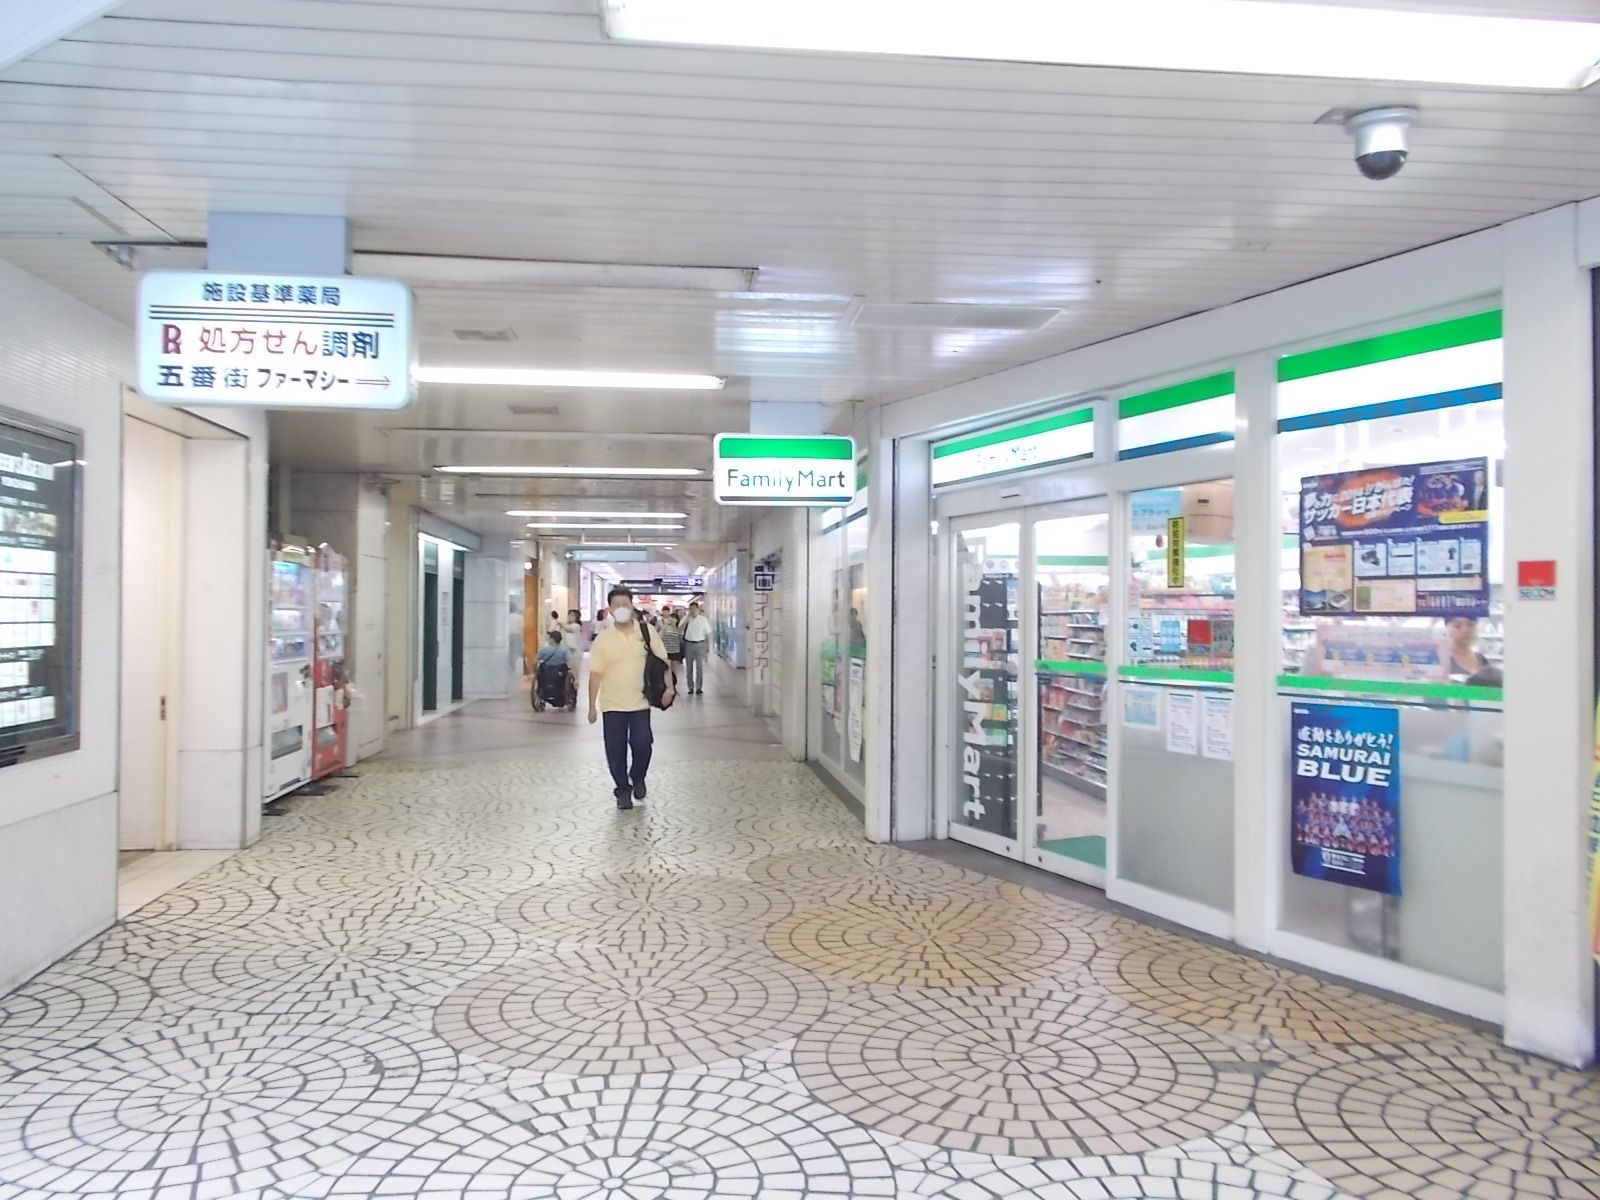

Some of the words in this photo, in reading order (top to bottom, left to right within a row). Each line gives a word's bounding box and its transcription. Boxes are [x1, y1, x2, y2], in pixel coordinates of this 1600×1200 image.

[202, 282, 341, 306] 施設基準薬局
[199, 325, 380, 360] 処方せん調剤
[727, 468, 846, 492] FamilyMart
[754, 592, 769, 681] コインロッカー
[1296, 744, 1391, 766] SAMURAI
[1296, 759, 1392, 787] BLUE
